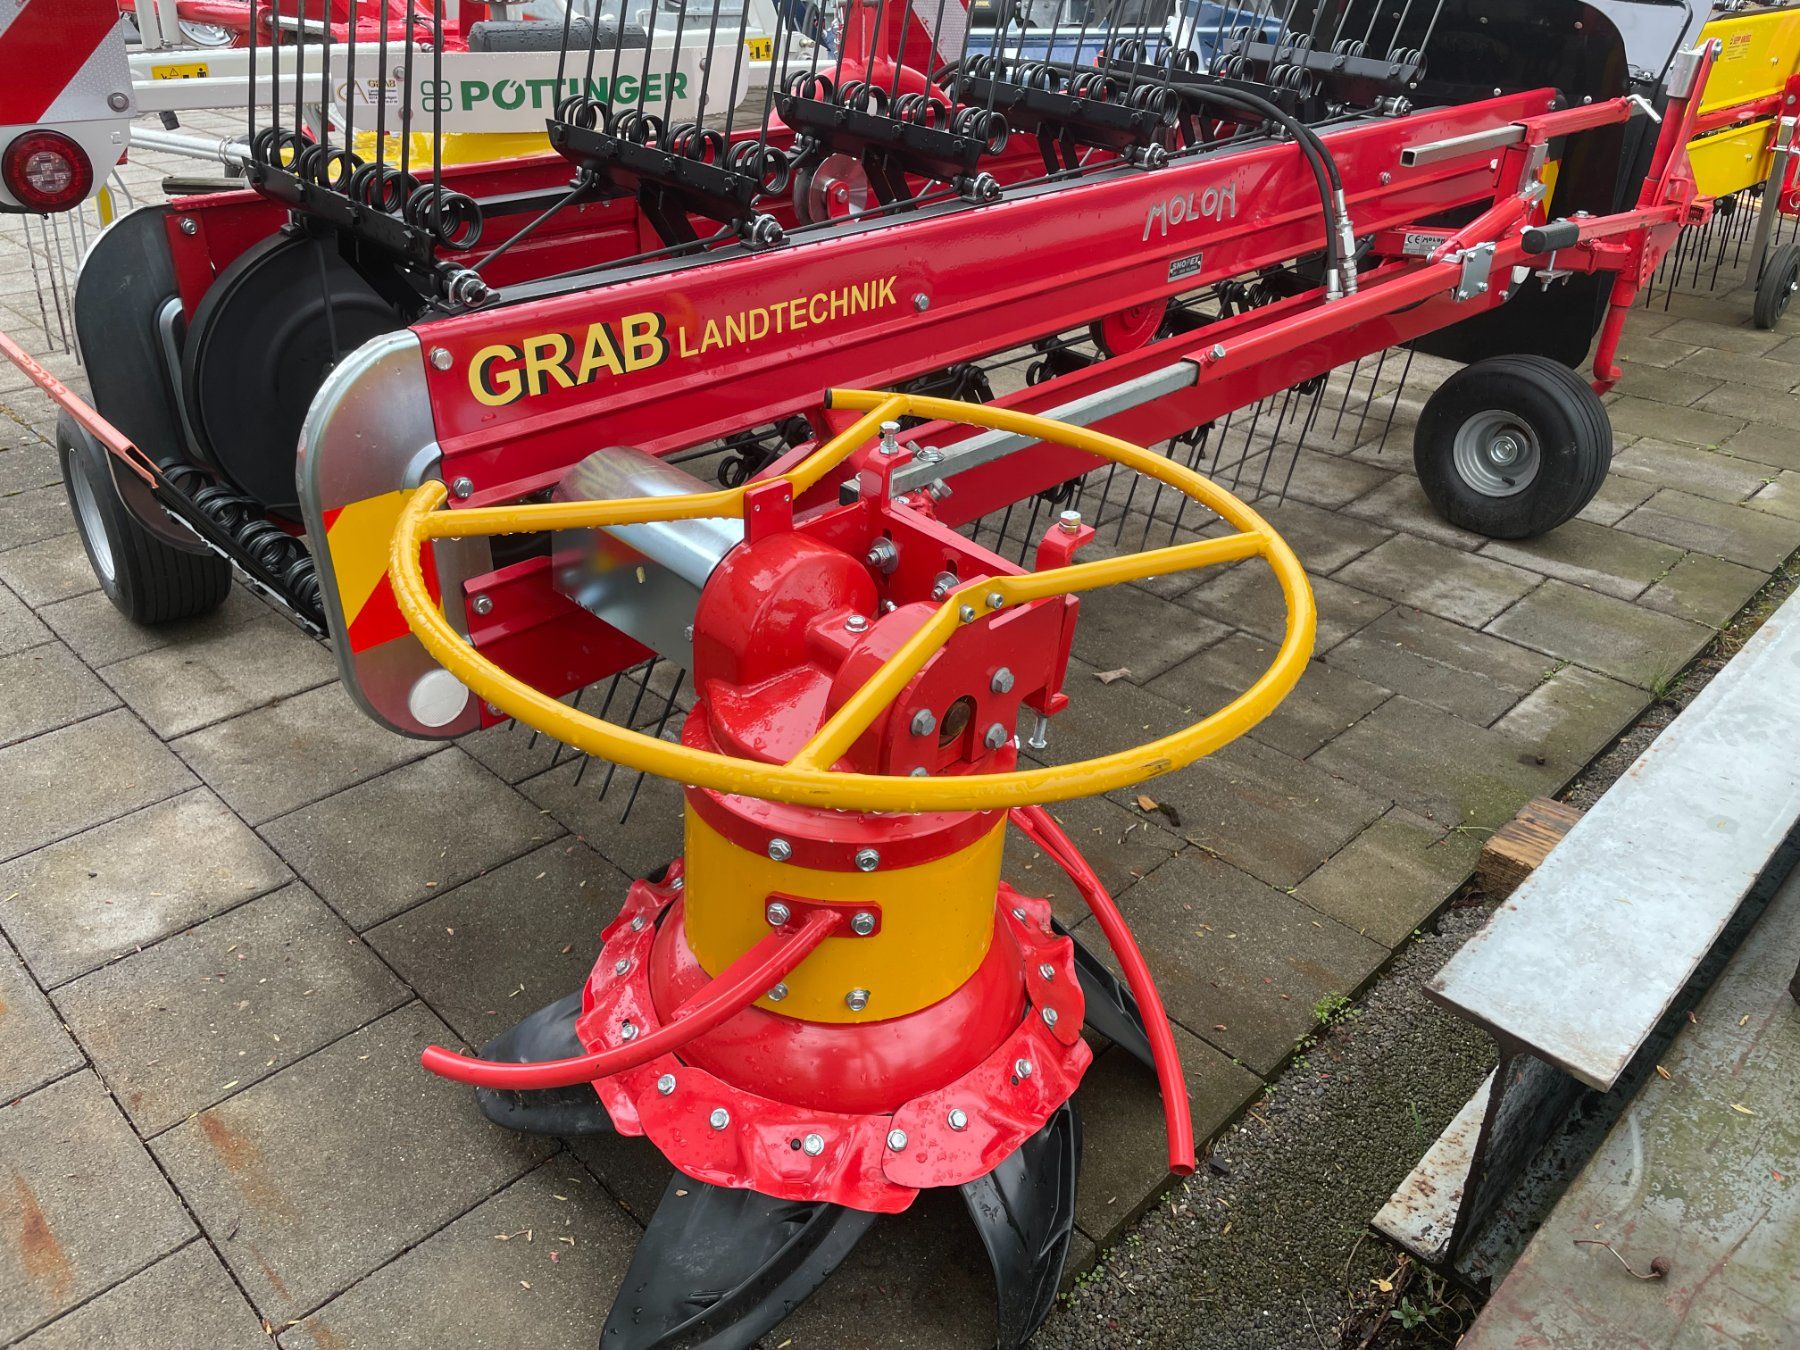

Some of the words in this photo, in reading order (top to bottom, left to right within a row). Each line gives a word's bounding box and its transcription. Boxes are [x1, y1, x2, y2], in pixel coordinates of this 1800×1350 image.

[460, 71, 688, 111] PÖTTINGER
[1142, 181, 1236, 241] MOLON
[468, 311, 670, 406] GRAB
[679, 275, 898, 358] LANDTECHNIK
